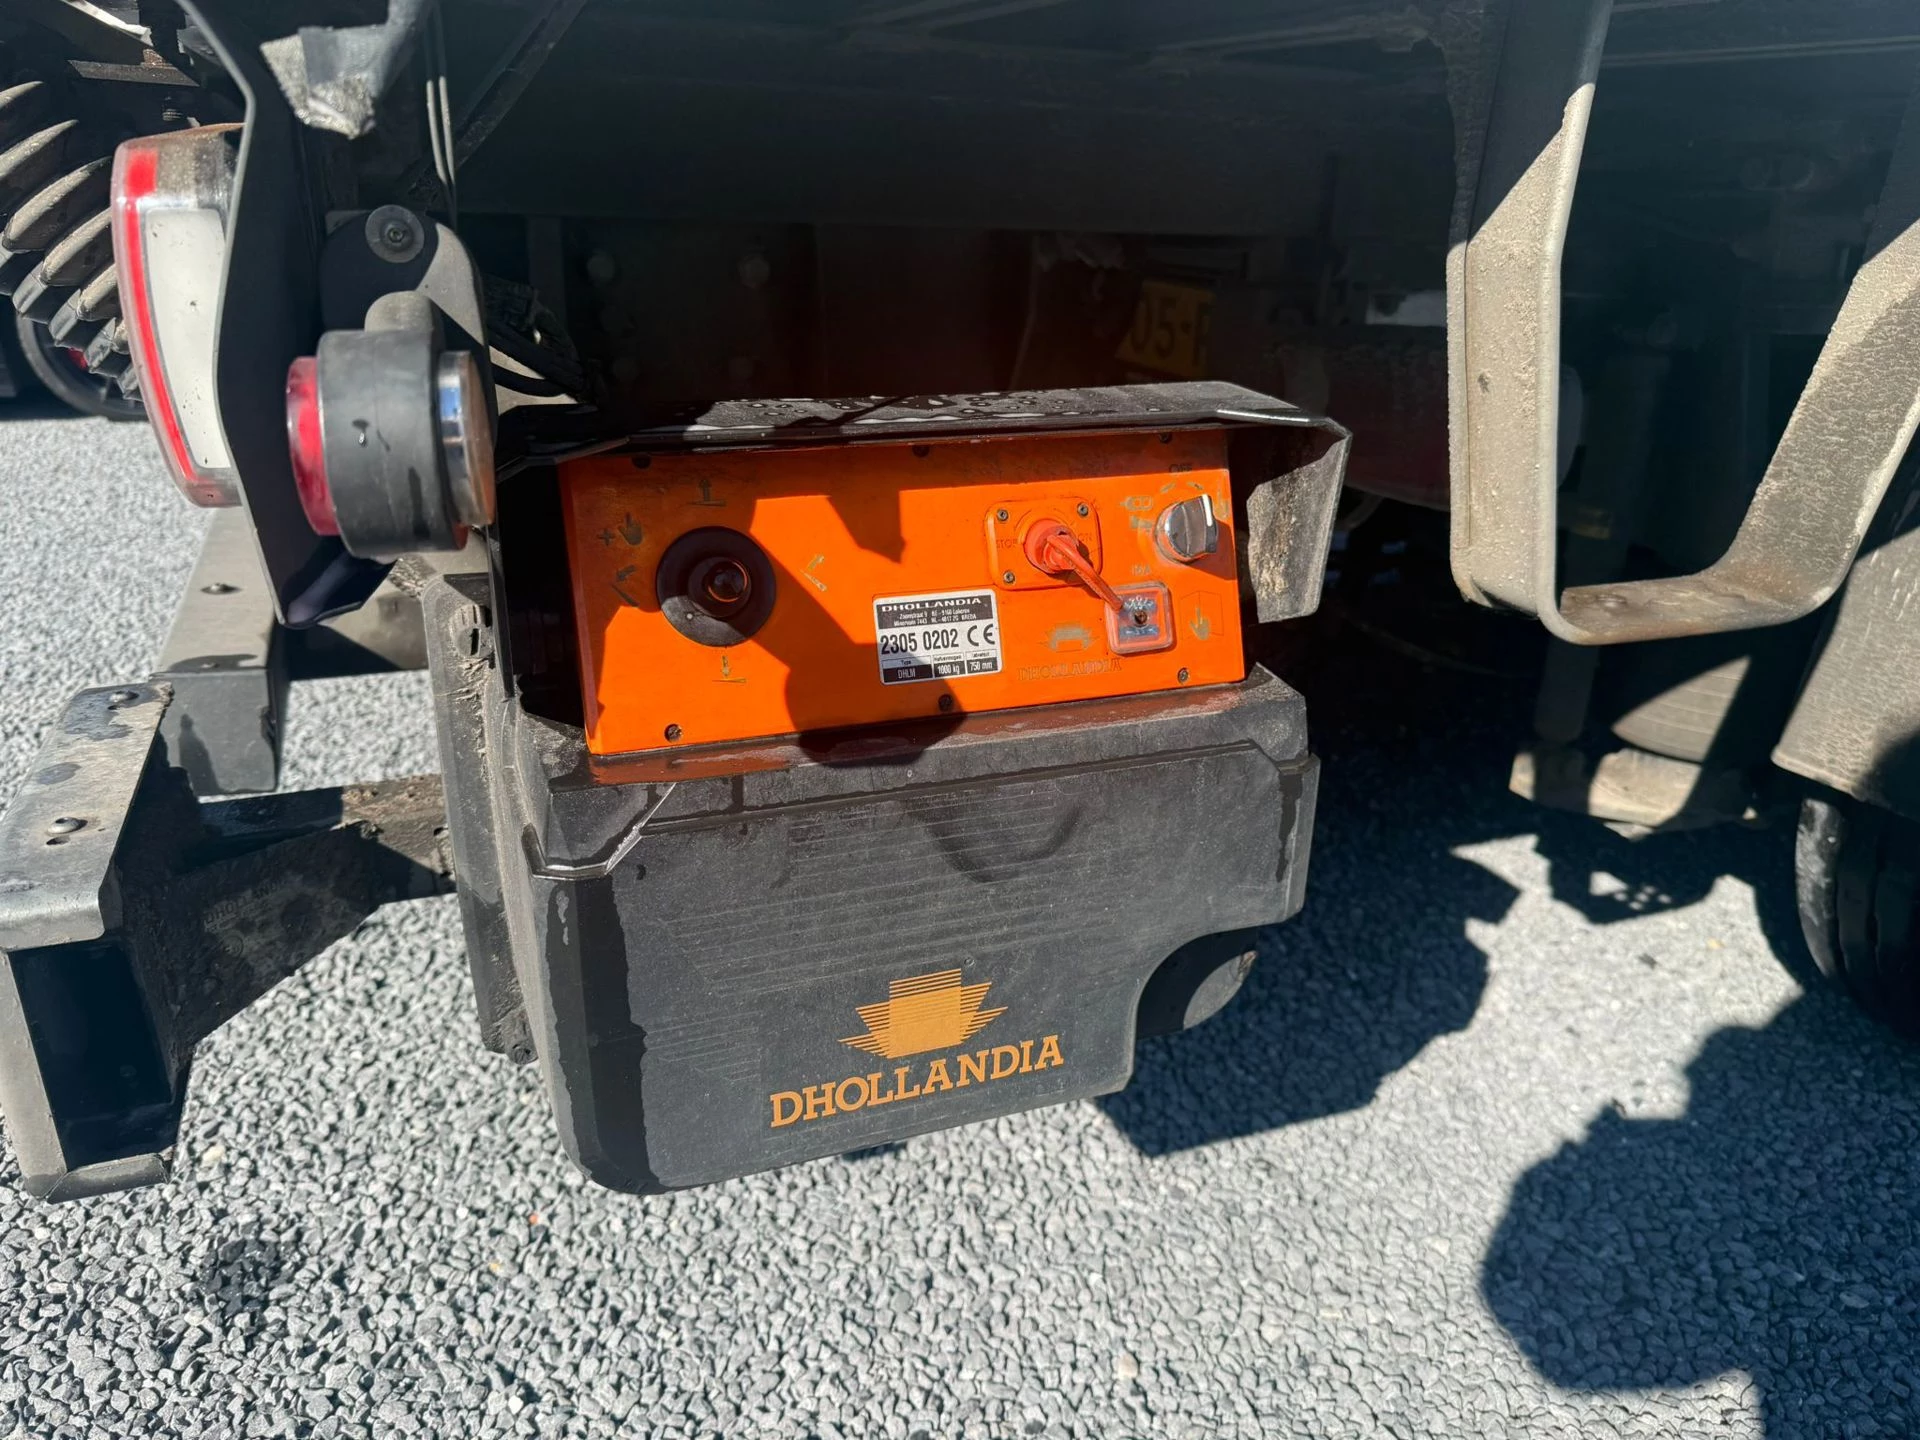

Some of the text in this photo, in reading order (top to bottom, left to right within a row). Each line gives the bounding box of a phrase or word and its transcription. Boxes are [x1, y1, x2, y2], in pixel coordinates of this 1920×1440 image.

[881, 597, 981, 612] DHOLLANDIA
[880, 623, 995, 655] 2305 0202 CE
[938, 664, 960, 675] 1000 kg
[969, 661, 993, 671] 750 mm
[897, 668, 916, 679] DHLM
[769, 1034, 1065, 1128] DHOLLANDIA
